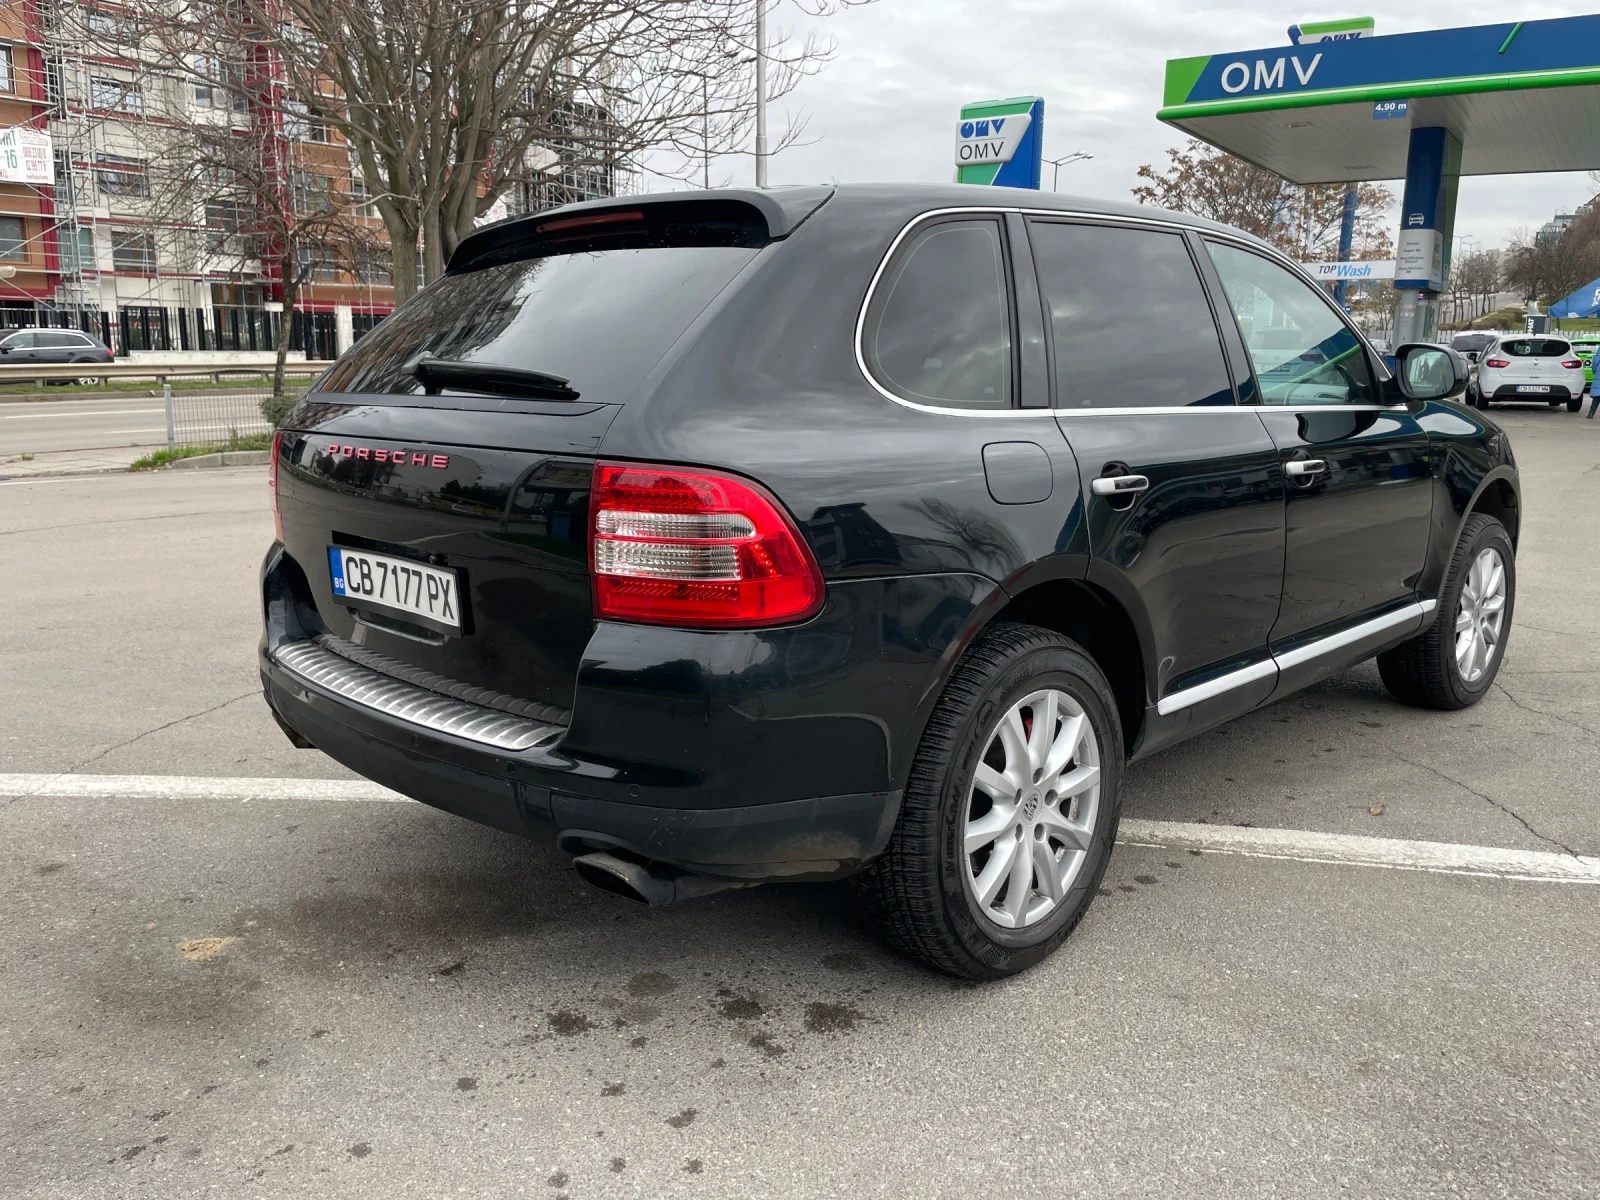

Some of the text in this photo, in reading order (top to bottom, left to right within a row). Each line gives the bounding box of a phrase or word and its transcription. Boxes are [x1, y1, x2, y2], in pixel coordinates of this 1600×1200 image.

[1221, 53, 1323, 93] OMV
[1375, 102, 1396, 111] 4.90
[4, 149, 18, 169] 16
[960, 141, 1004, 160] OMV
[328, 444, 451, 470] PORSCHE
[334, 577, 345, 589] BG
